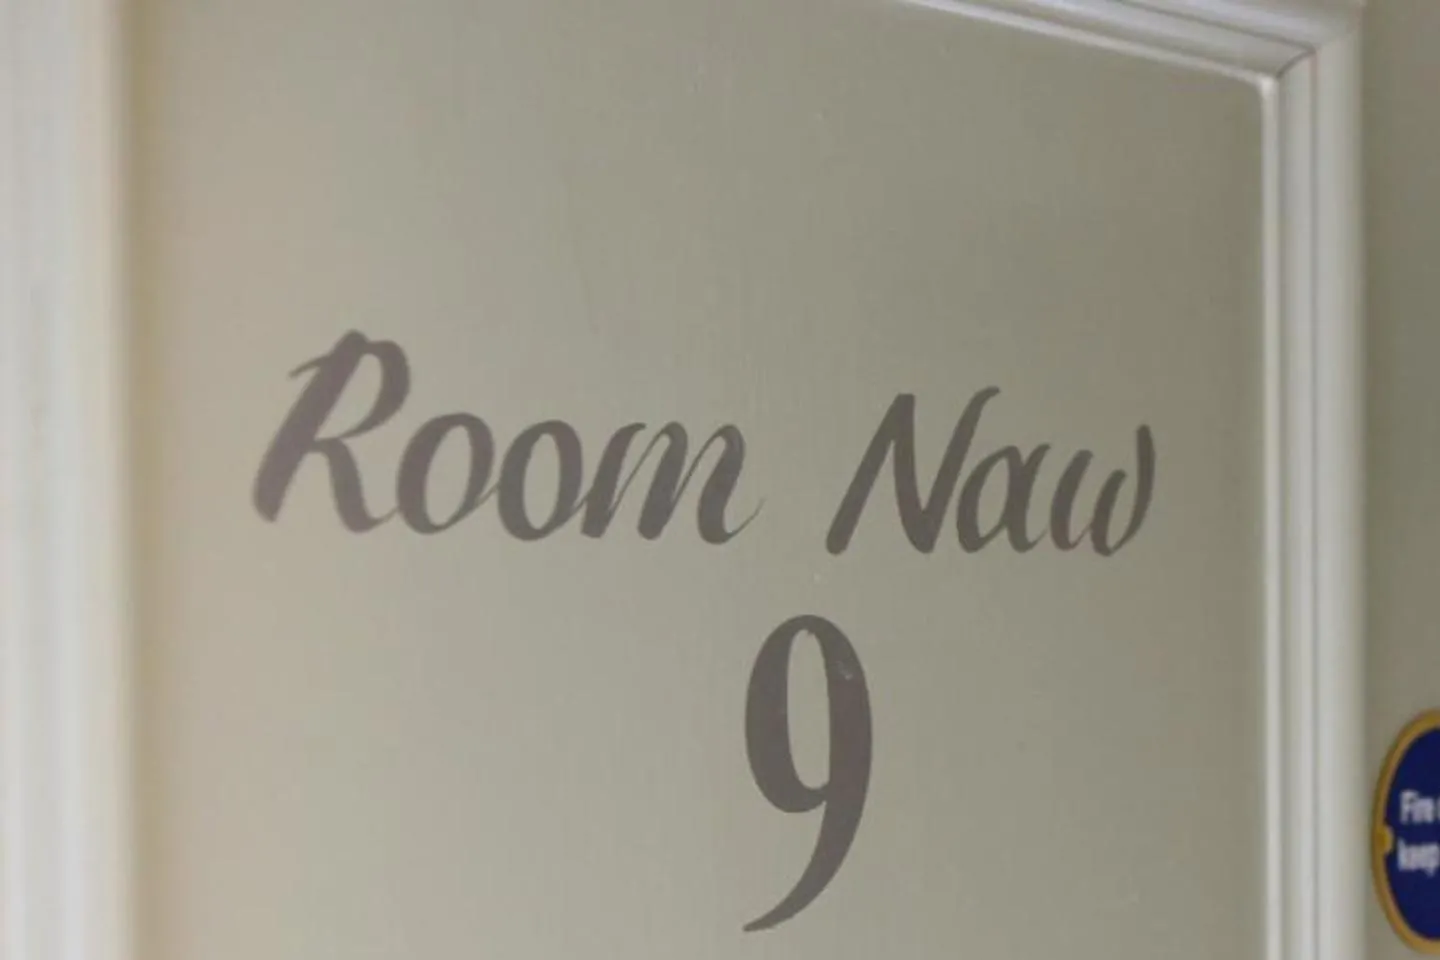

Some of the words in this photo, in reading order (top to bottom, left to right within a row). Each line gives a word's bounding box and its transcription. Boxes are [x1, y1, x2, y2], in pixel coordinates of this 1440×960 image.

[252, 330, 764, 544] Room
[825, 386, 1156, 556] Naw
[743, 614, 873, 932] 9
[1400, 789, 1435, 824] Fire
